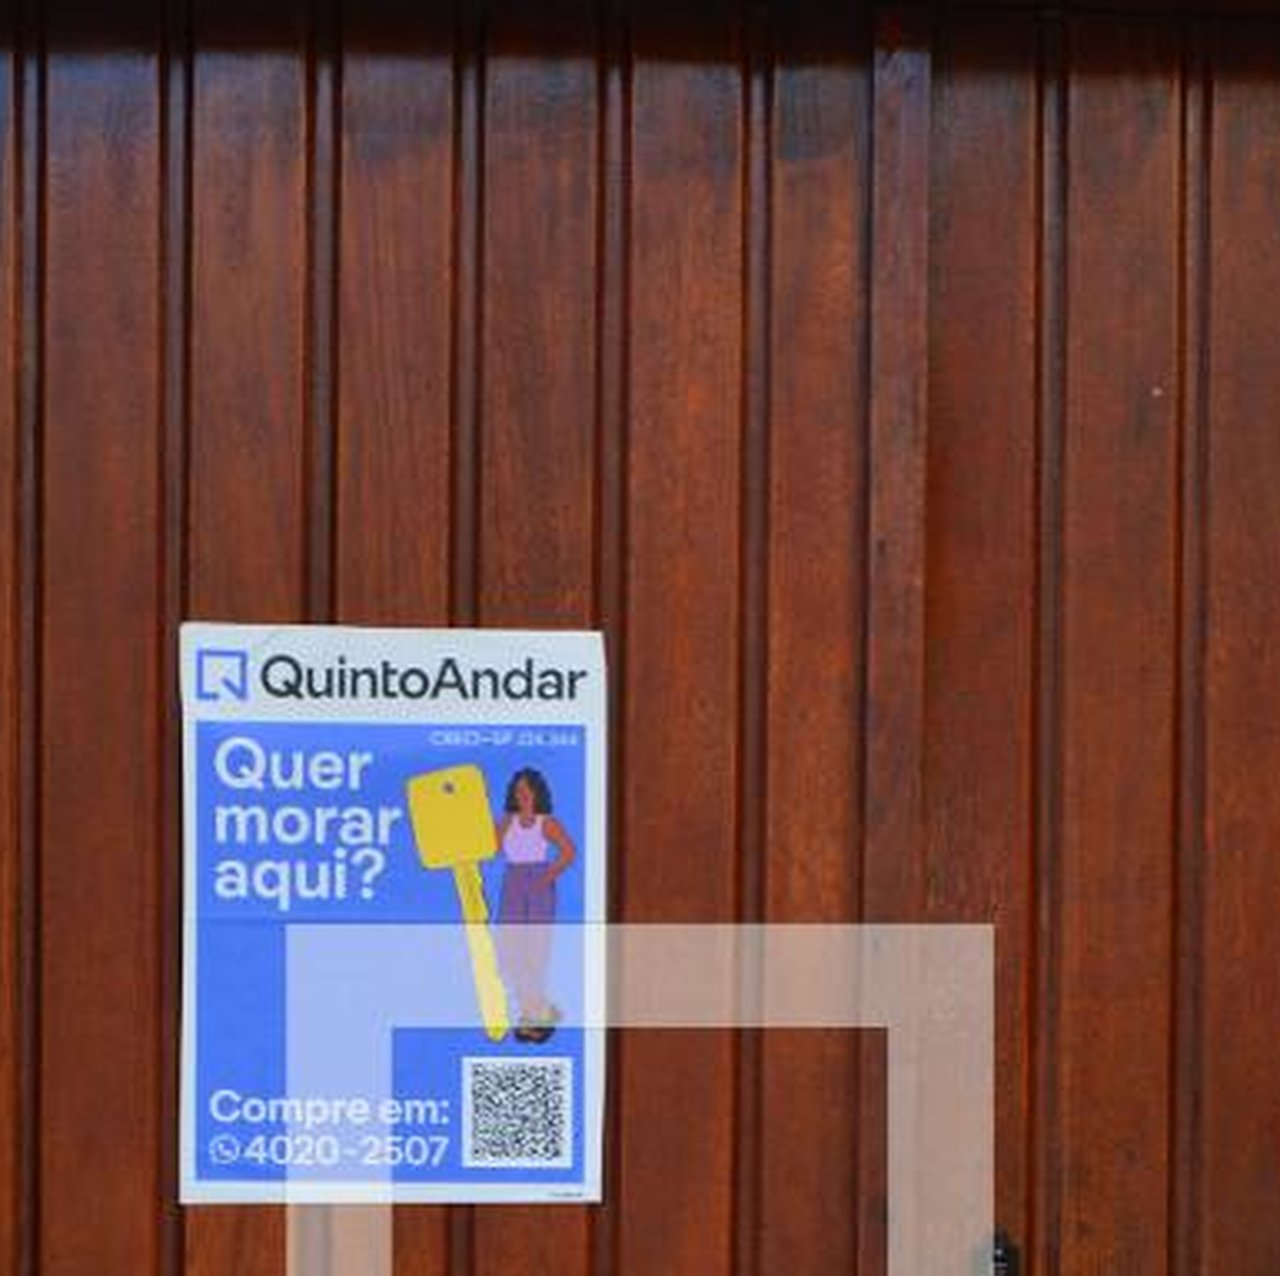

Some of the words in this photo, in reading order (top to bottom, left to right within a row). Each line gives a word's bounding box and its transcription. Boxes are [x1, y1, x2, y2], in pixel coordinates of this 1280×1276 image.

[260, 654, 588, 700] QuintoAndar
[214, 737, 373, 790] Quer
[214, 805, 401, 845] morar
[214, 849, 385, 911] aqui?
[209, 1089, 371, 1127] Compre
[378, 1099, 450, 1125] em:
[244, 1135, 450, 1166] 4020-2507
